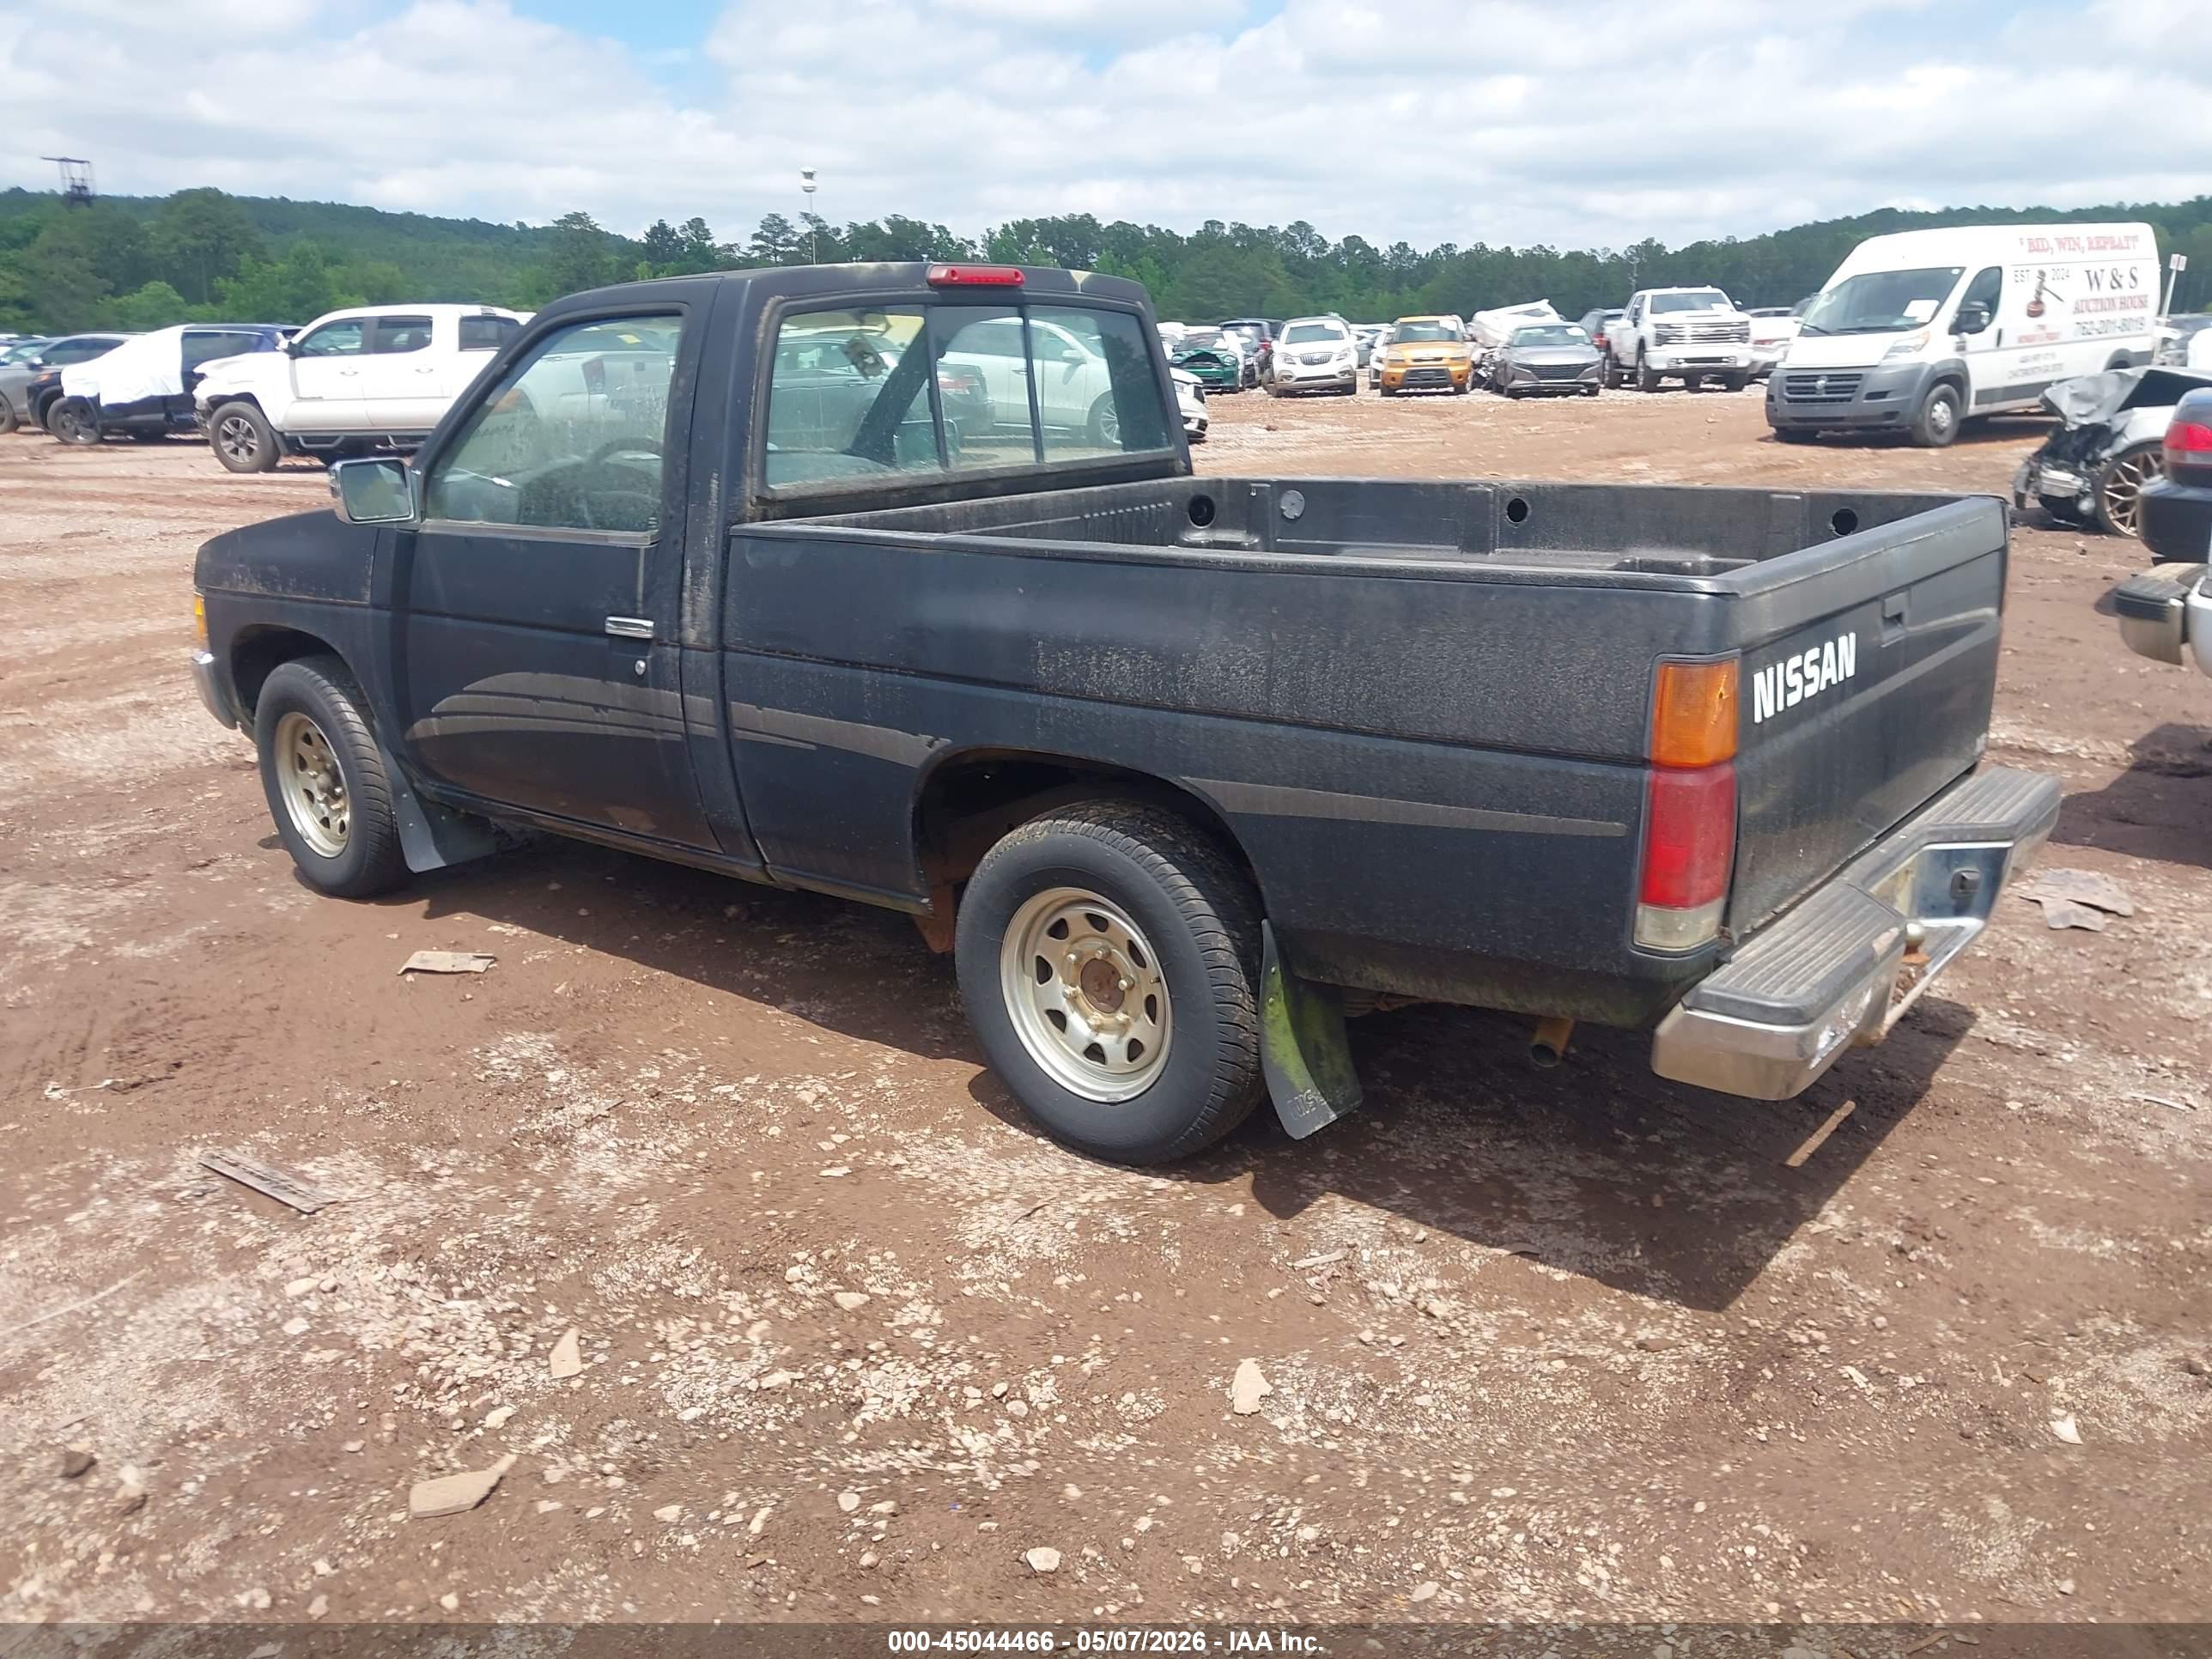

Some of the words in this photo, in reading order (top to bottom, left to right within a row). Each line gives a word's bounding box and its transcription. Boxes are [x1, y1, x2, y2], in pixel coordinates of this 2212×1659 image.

[2051, 268, 2070, 281] 2024
[2085, 269, 2105, 292] W
[2110, 267, 2124, 290] &
[2129, 266, 2138, 289] S
[2073, 298, 2117, 315] AUCTION
[2118, 295, 2148, 310] HOUSE
[1753, 632, 1856, 723] NISSAN
